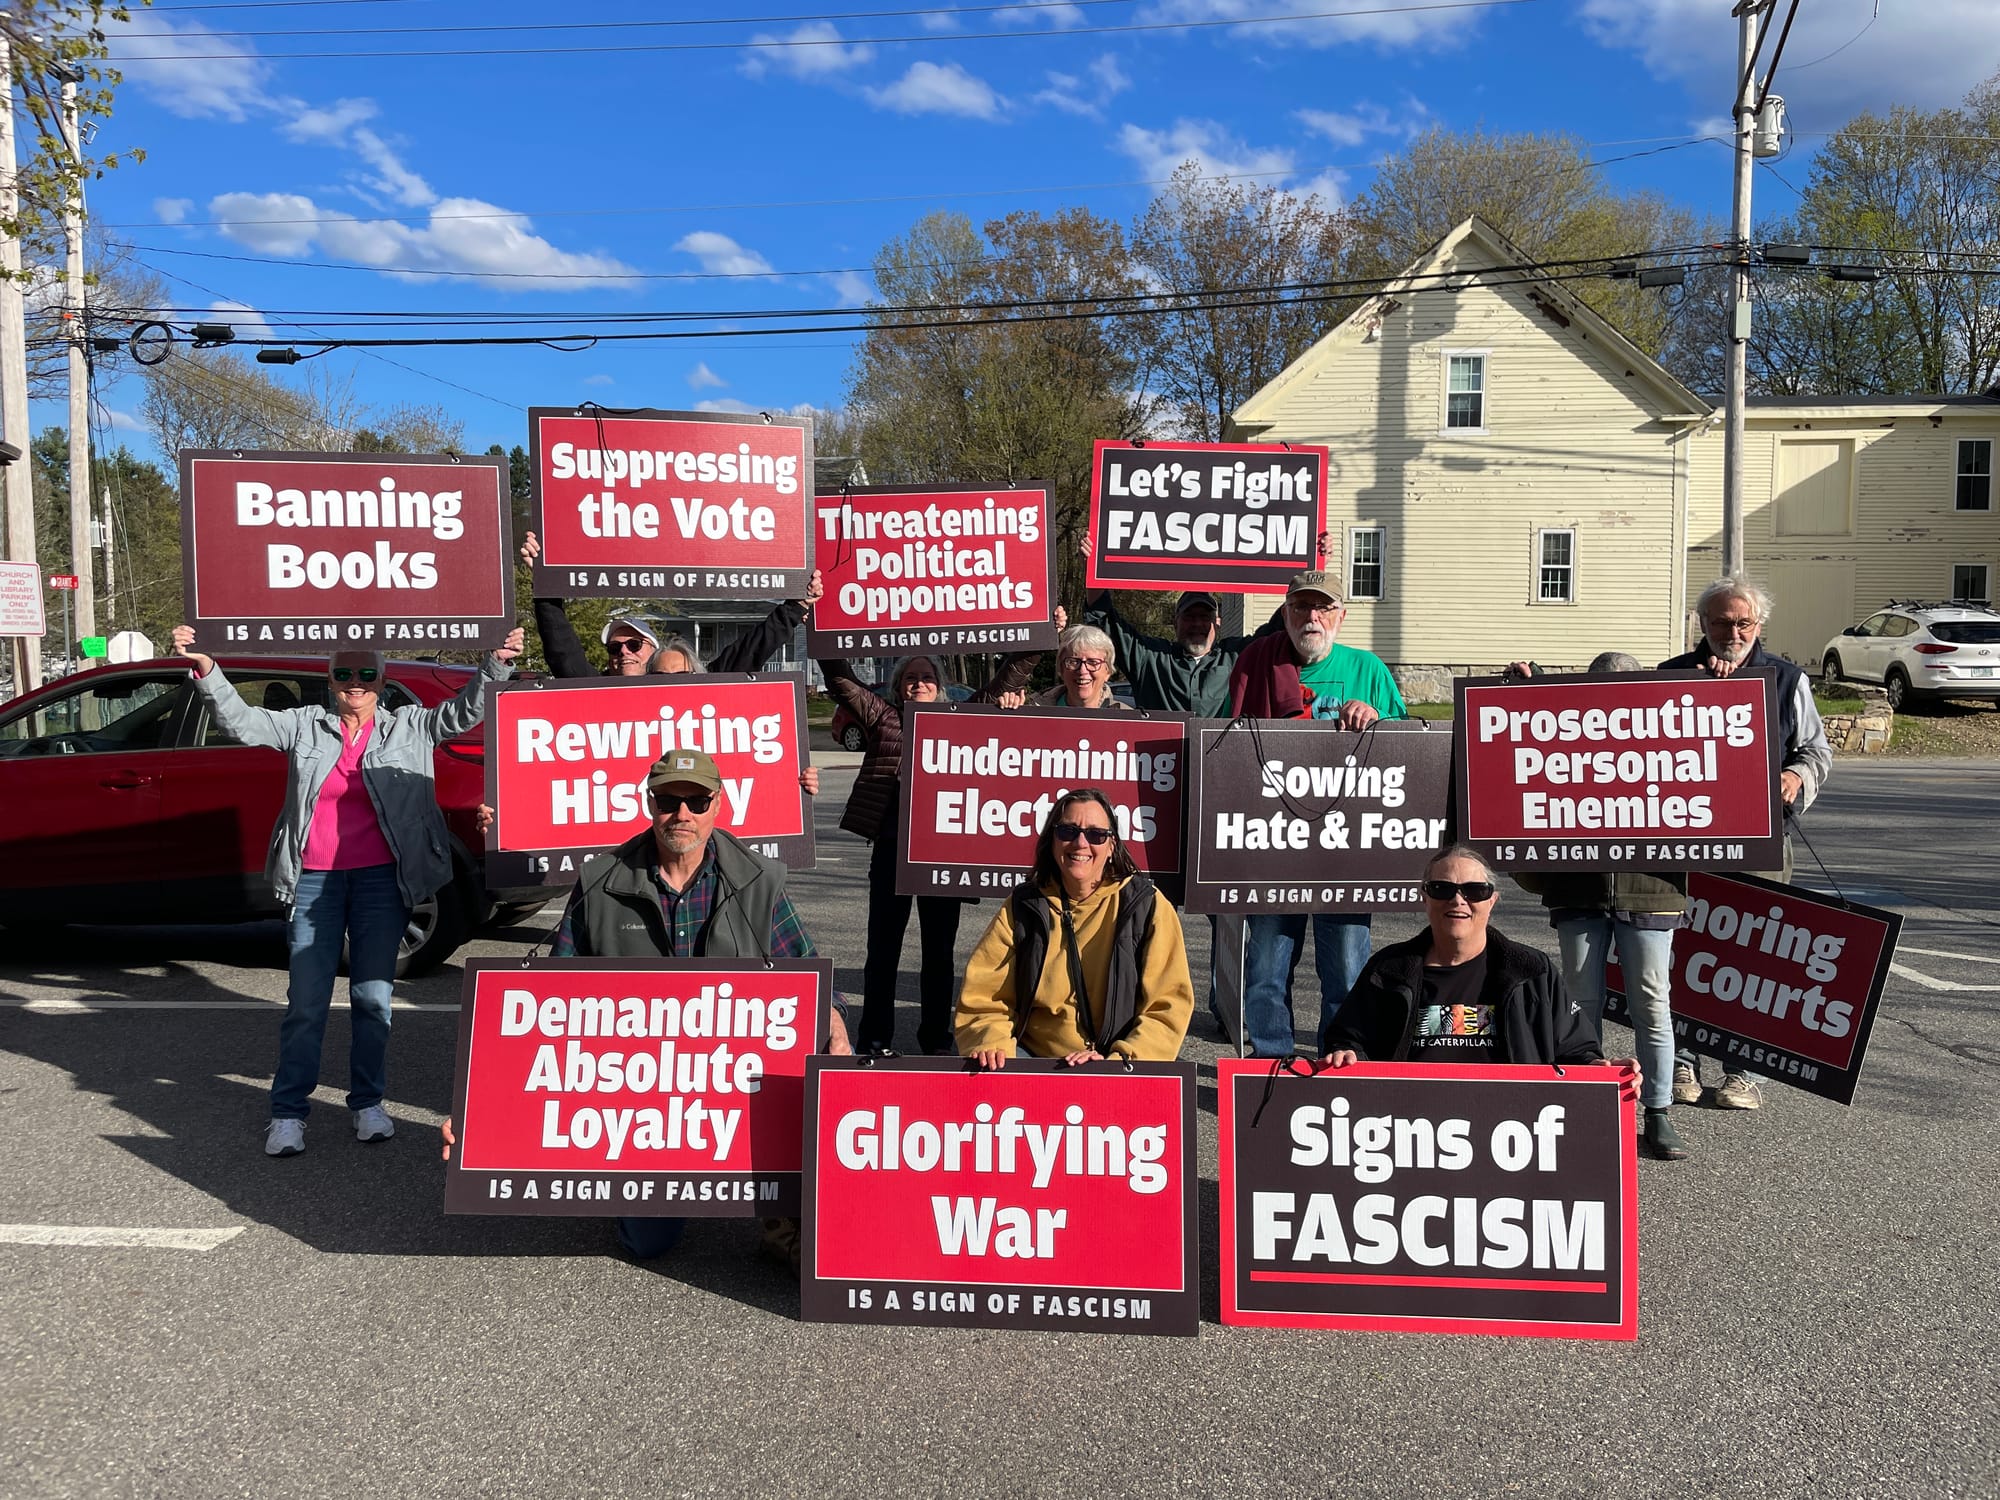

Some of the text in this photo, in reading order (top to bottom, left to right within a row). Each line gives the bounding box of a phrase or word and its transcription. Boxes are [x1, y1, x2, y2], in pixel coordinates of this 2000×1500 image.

[551, 442, 798, 494] Suppressing
[1109, 461, 1312, 509] Let's Fight
[236, 476, 464, 541] Banning
[577, 492, 775, 542] the Vote
[818, 498, 1038, 543] Threatening
[1107, 510, 1308, 556] FASCISM
[268, 541, 438, 589] Books
[569, 572, 785, 589] IS A SIGN OF FASCISM
[856, 539, 1005, 580] Political
[839, 575, 1033, 622] Opponents
[227, 623, 480, 640] IS A SIGN OF FASCISM
[838, 628, 1030, 649] IS A SIGN OF FASCISM
[517, 704, 782, 763] Rewriting
[1480, 694, 1753, 747] Prosecuting
[922, 739, 1176, 792] Undermining
[1262, 755, 1406, 807] Sowing
[1515, 740, 1717, 784] Personal
[552, 771, 754, 825] Histy
[1522, 784, 1712, 829] Enemies
[1216, 810, 1447, 849] Hate & Fear
[1497, 844, 1744, 860] IS A SIGN OF FASCISM
[528, 856, 549, 872] IS
[559, 855, 573, 871] A
[933, 870, 1026, 887] IS A SIGN
[1221, 888, 1423, 903] IS A SIGN OF FASCIS
[500, 983, 798, 1051] Demanding
[1685, 952, 1854, 1038] Courts
[1411, 1038, 1493, 1047] HE CATERPILLAR
[1696, 1028, 1721, 1047] OF
[1728, 1039, 1819, 1081] FASCISM
[524, 1040, 764, 1094] Absolute
[542, 1096, 742, 1161] Loyalty
[835, 1103, 1167, 1194] Glorifying
[1289, 1097, 1565, 1183] Signs of
[490, 1179, 779, 1201] IS A SIGN OF FASCISM
[931, 1196, 1067, 1259] War
[1252, 1192, 1606, 1270] FASCISM
[848, 1289, 1151, 1319] IS A SIGN OF FASCISM
